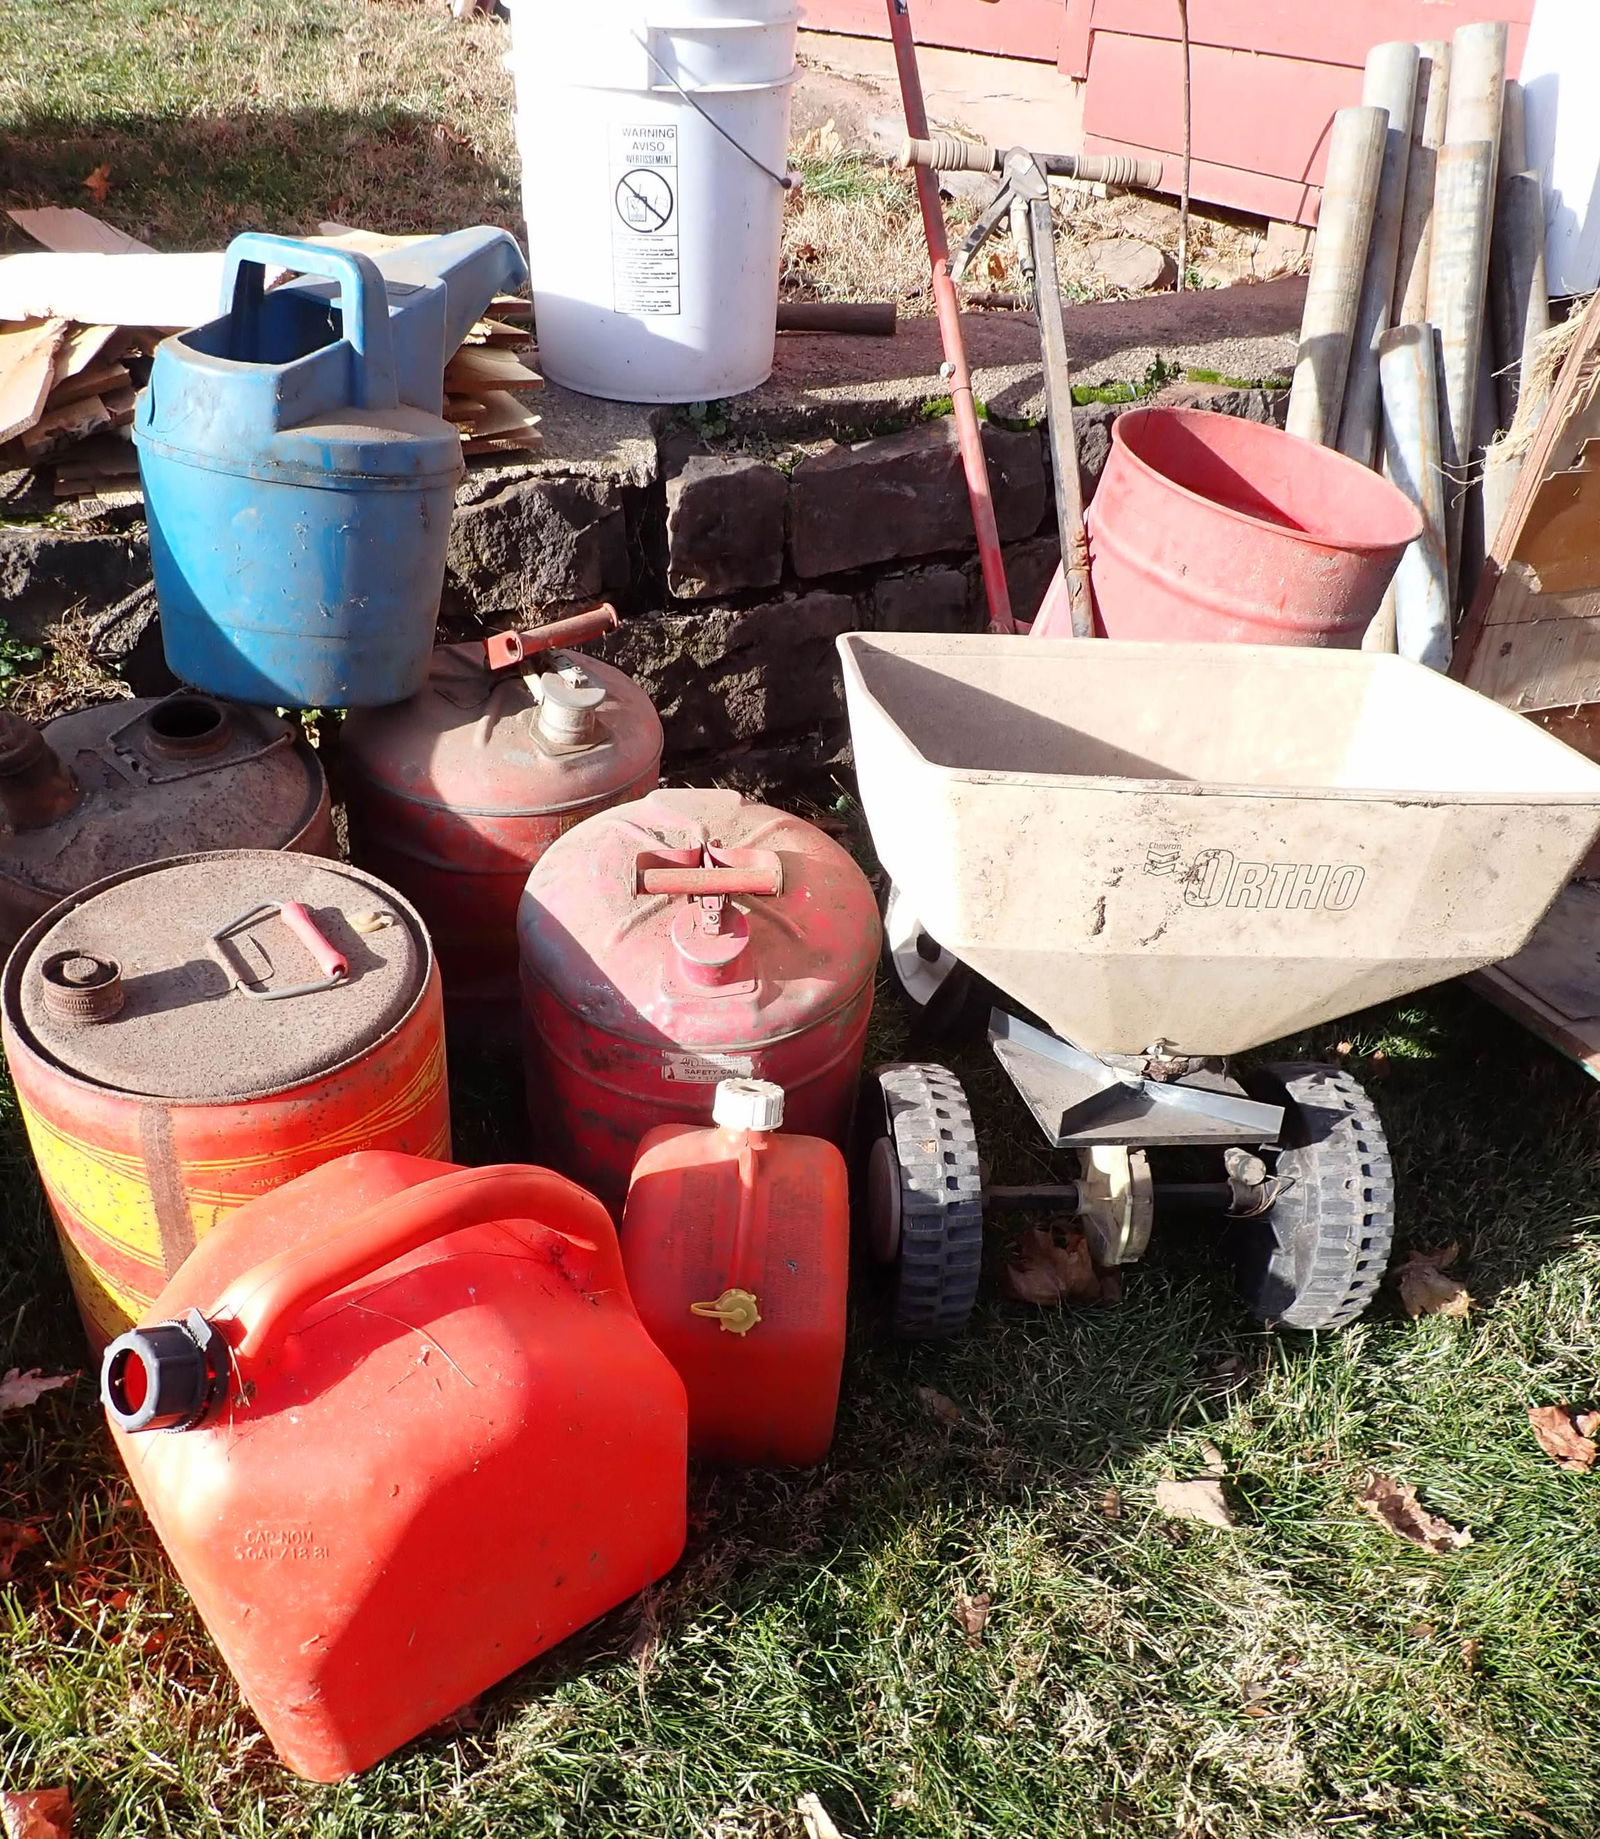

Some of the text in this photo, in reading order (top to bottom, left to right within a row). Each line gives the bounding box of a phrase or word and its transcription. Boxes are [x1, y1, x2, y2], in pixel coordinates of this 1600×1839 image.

[623, 128, 675, 138] WARNING
[632, 141, 665, 152] AVISO
[1148, 842, 1182, 851] Chevron
[1184, 849, 1366, 911] ORTHO
[684, 1068, 718, 1076] SAFETY
